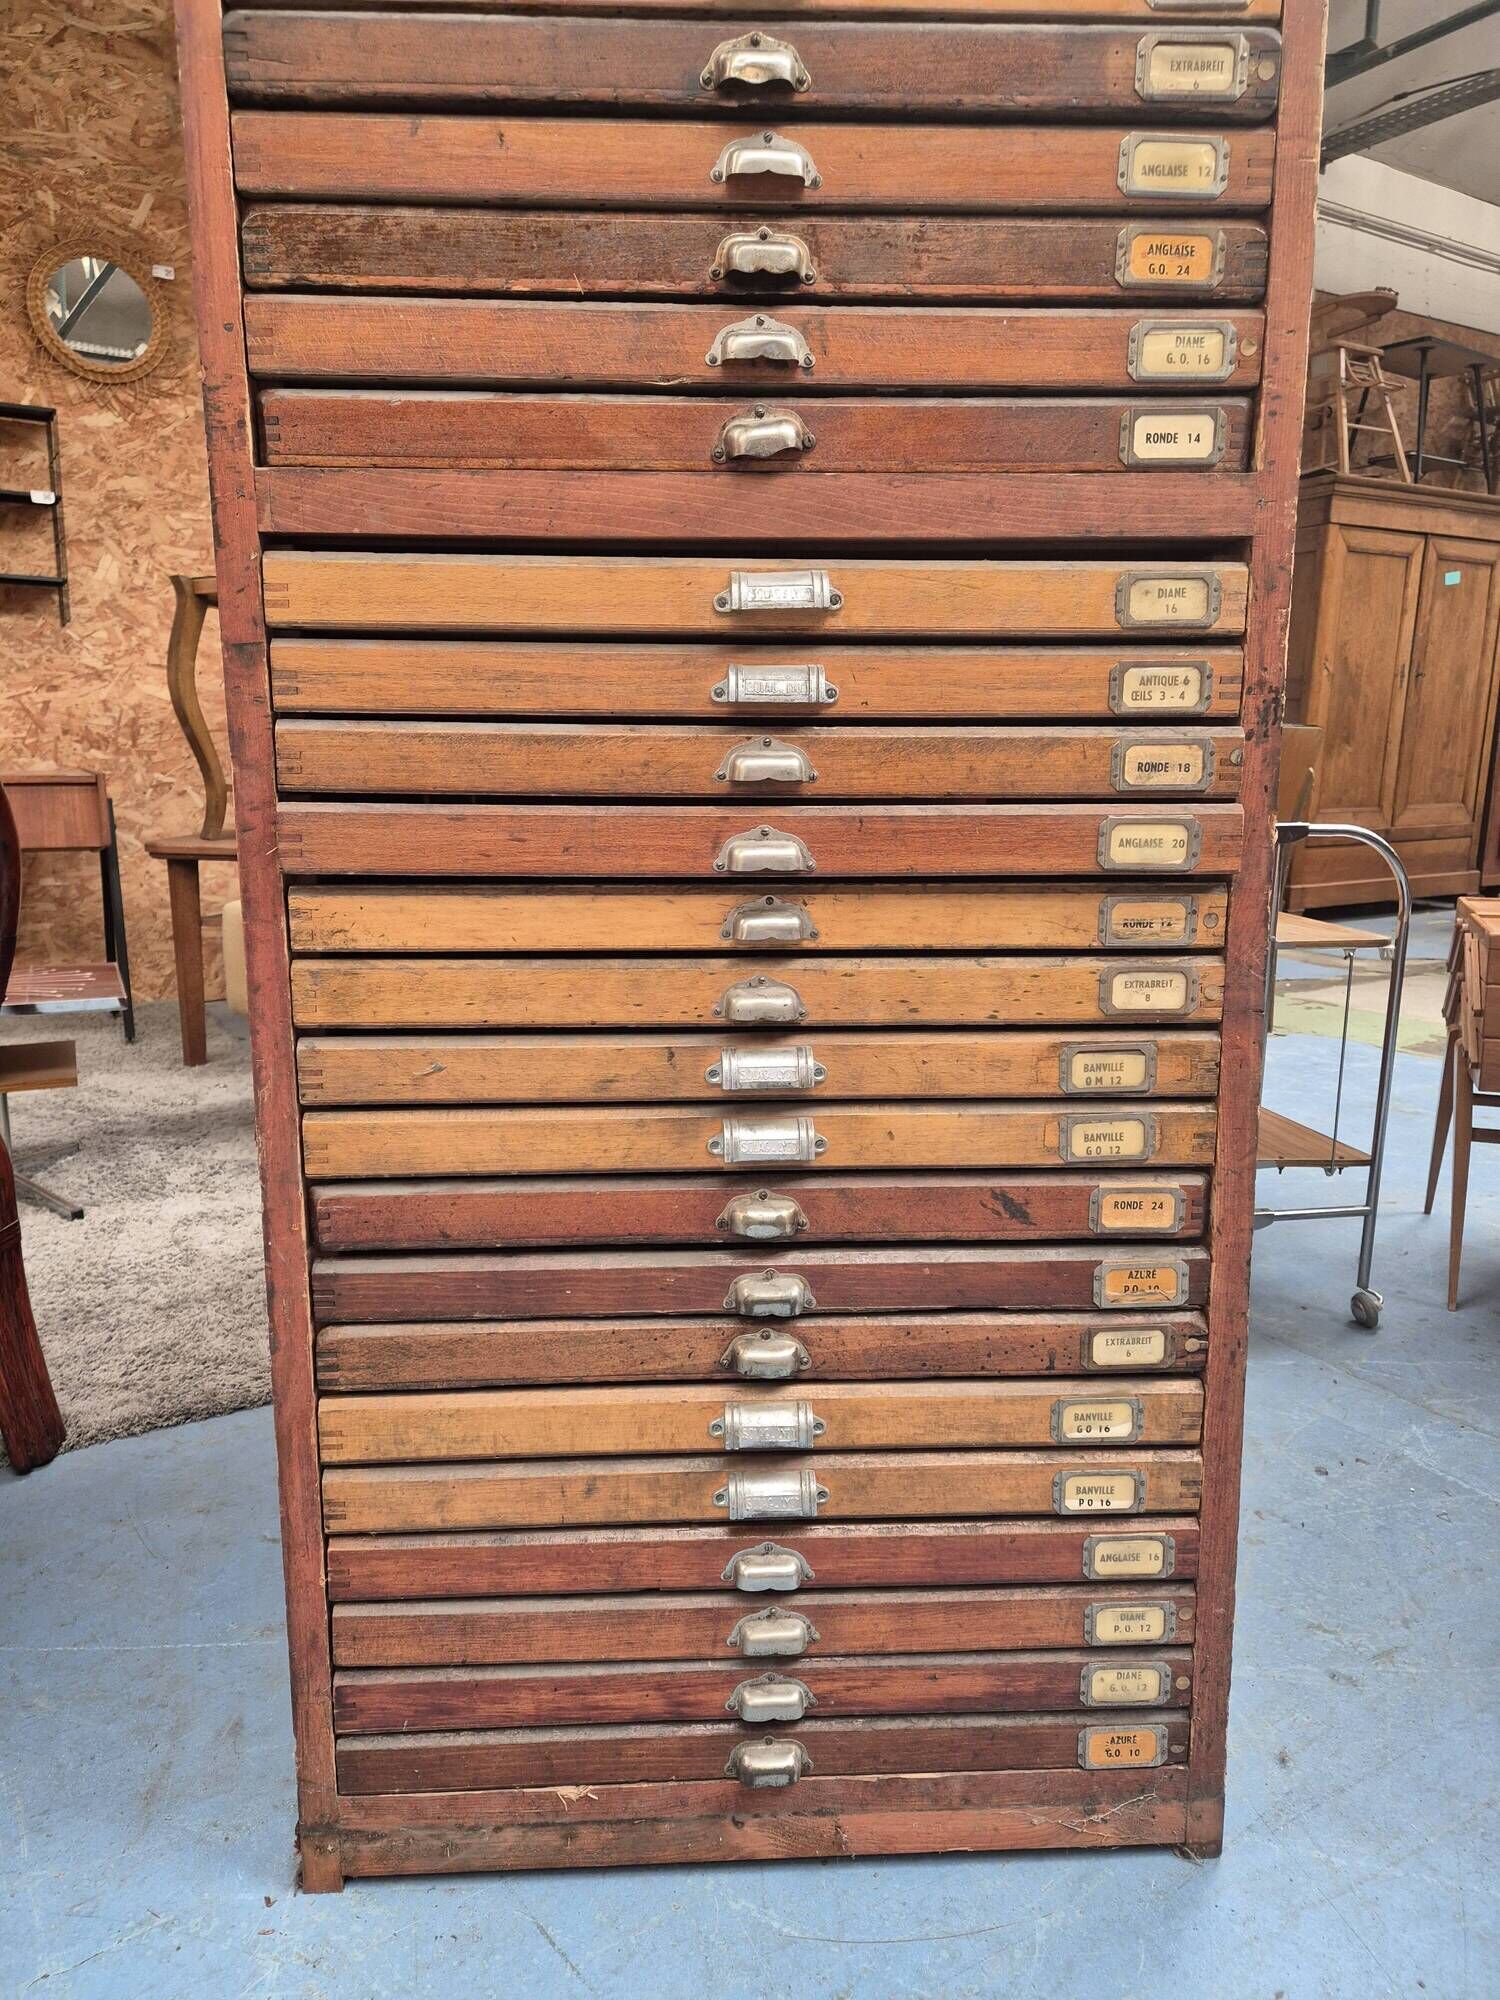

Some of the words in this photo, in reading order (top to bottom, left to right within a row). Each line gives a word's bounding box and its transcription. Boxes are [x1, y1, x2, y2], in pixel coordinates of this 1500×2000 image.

[1169, 60, 1225, 73] EXTRABREIT
[1193, 80, 1200, 90] 6
[1141, 164, 1189, 176] ANGLAISE
[1199, 166, 1211, 177] 12
[1147, 243, 1196, 257] ANGLAISE
[1148, 263, 1168, 275] G.O.
[1177, 264, 1190, 276] 24
[1175, 336, 1206, 349] DIANE
[1198, 353, 1210, 365] 16
[1145, 432, 1178, 444] RONDE
[1188, 433, 1201, 444] 14
[1157, 587, 1187, 599] DIANE
[1166, 604, 1177, 614] 16
[1139, 675, 1180, 687] ANTIQUE
[1182, 675, 1190, 686] 6
[1137, 762, 1170, 773] RONDE
[1177, 763, 1191, 773] 18
[1118, 837, 1164, 849] ANGLAISE
[1172, 839, 1185, 848] 20
[1122, 918, 1154, 929] RONDE
[1124, 979, 1174, 989] EXTRABREIT
[1145, 994, 1151, 1002] 8
[1083, 1062, 1124, 1073] BANVILLE
[1110, 1076, 1122, 1085] 12
[1084, 1132, 1124, 1143] BANVILLE
[1109, 1146, 1121, 1155] 12
[1113, 1201, 1143, 1211] RONDE
[1151, 1201, 1164, 1210] 24
[1127, 1269, 1157, 1280] AZURÉ
[1105, 1336, 1152, 1347] EXTRABREIT
[1074, 1412, 1113, 1422] BANVILLE
[1099, 1425, 1110, 1433] 16
[1075, 1485, 1115, 1496] BANVILLE
[1100, 1499, 1112, 1507] 16
[1100, 1553, 1141, 1563] ANGLAISE
[1149, 1553, 1160, 1561] 16
[1120, 1612, 1146, 1621] DIANE
[1140, 1624, 1152, 1632] 12
[1116, 1671, 1143, 1681] DIANE
[1136, 1683, 1147, 1692] 12
[1110, 1735, 1137, 1745] AZURÉ
[1129, 1749, 1141, 1757] 10
